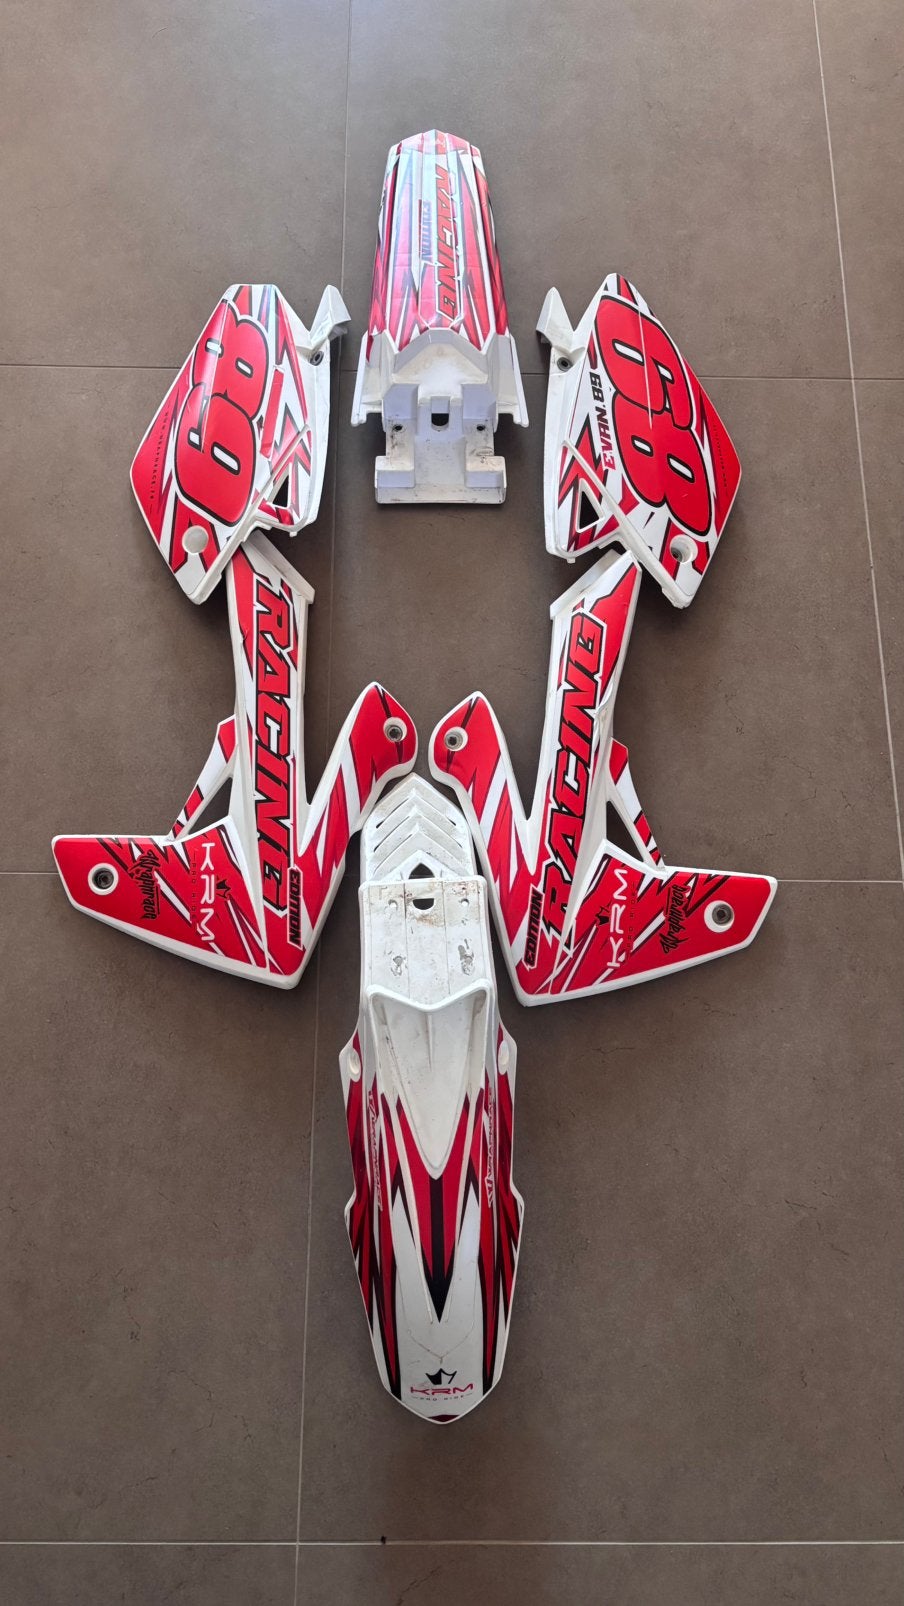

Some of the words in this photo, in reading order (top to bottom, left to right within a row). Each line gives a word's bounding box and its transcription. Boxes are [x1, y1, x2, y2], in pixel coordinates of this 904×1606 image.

[435, 164, 463, 321] RACING
[174, 300, 269, 527] 89
[590, 372, 616, 471] EVAN.89
[594, 295, 712, 537] 89
[255, 580, 292, 912] RACING
[542, 612, 604, 951] RACING
[200, 842, 215, 941] KRM
[289, 868, 301, 947] EDITION
[525, 889, 543, 969] EDITION
[607, 868, 628, 968] KRM
[410, 1383, 473, 1396] KRM
